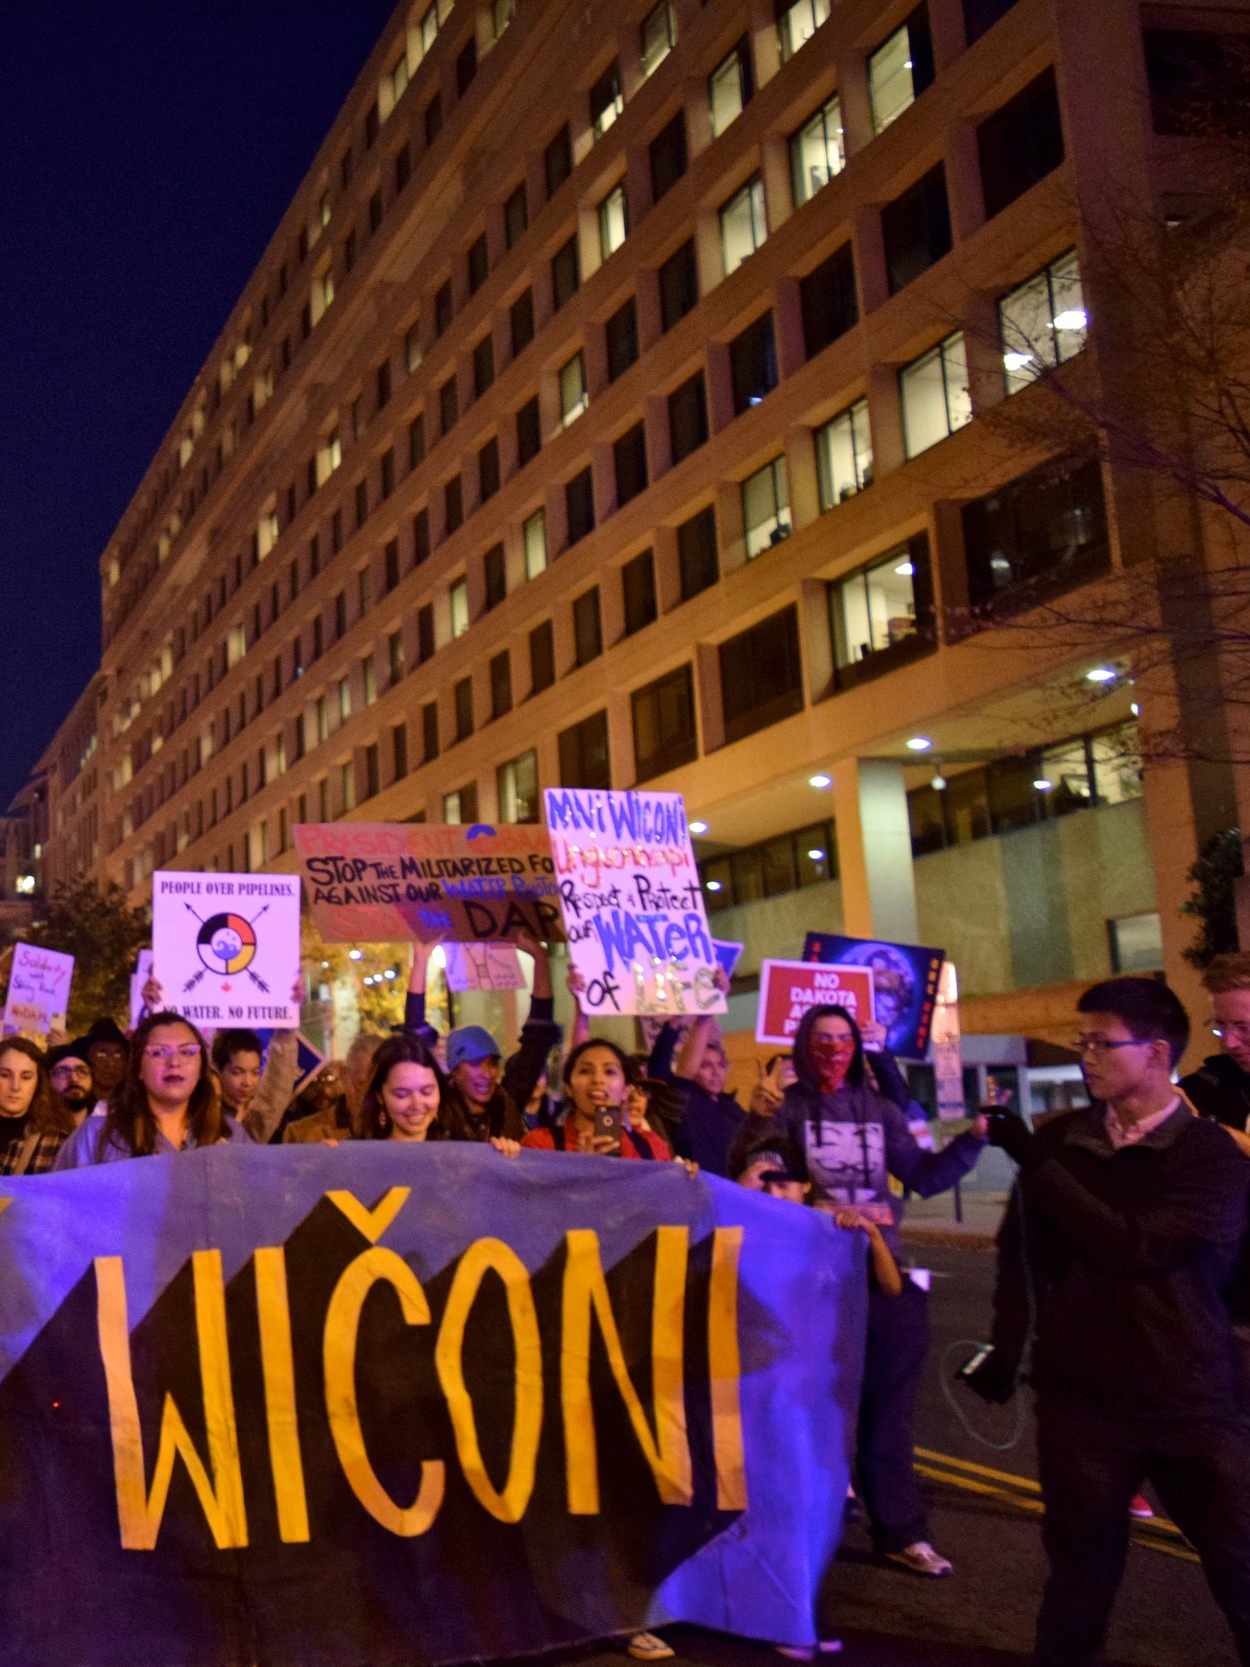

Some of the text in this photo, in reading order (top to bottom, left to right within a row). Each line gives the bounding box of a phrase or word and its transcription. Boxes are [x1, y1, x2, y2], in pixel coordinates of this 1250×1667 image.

[306, 856, 368, 886] STOP
[368, 862, 399, 880] THE
[400, 855, 525, 880] MILITARIZED
[161, 881, 295, 896] PEOPLE OVER PIPELINES.
[314, 884, 401, 905] AGAINST
[406, 883, 443, 903] OUR
[463, 900, 559, 938] DAP
[813, 972, 840, 988] NO
[790, 986, 857, 1006] DAKOTA
[182, 1005, 223, 1019] WATER.
[228, 1006, 243, 1019] NO
[247, 1006, 293, 1020] FUTURE.
[94, 1186, 749, 1552] WIČONI
